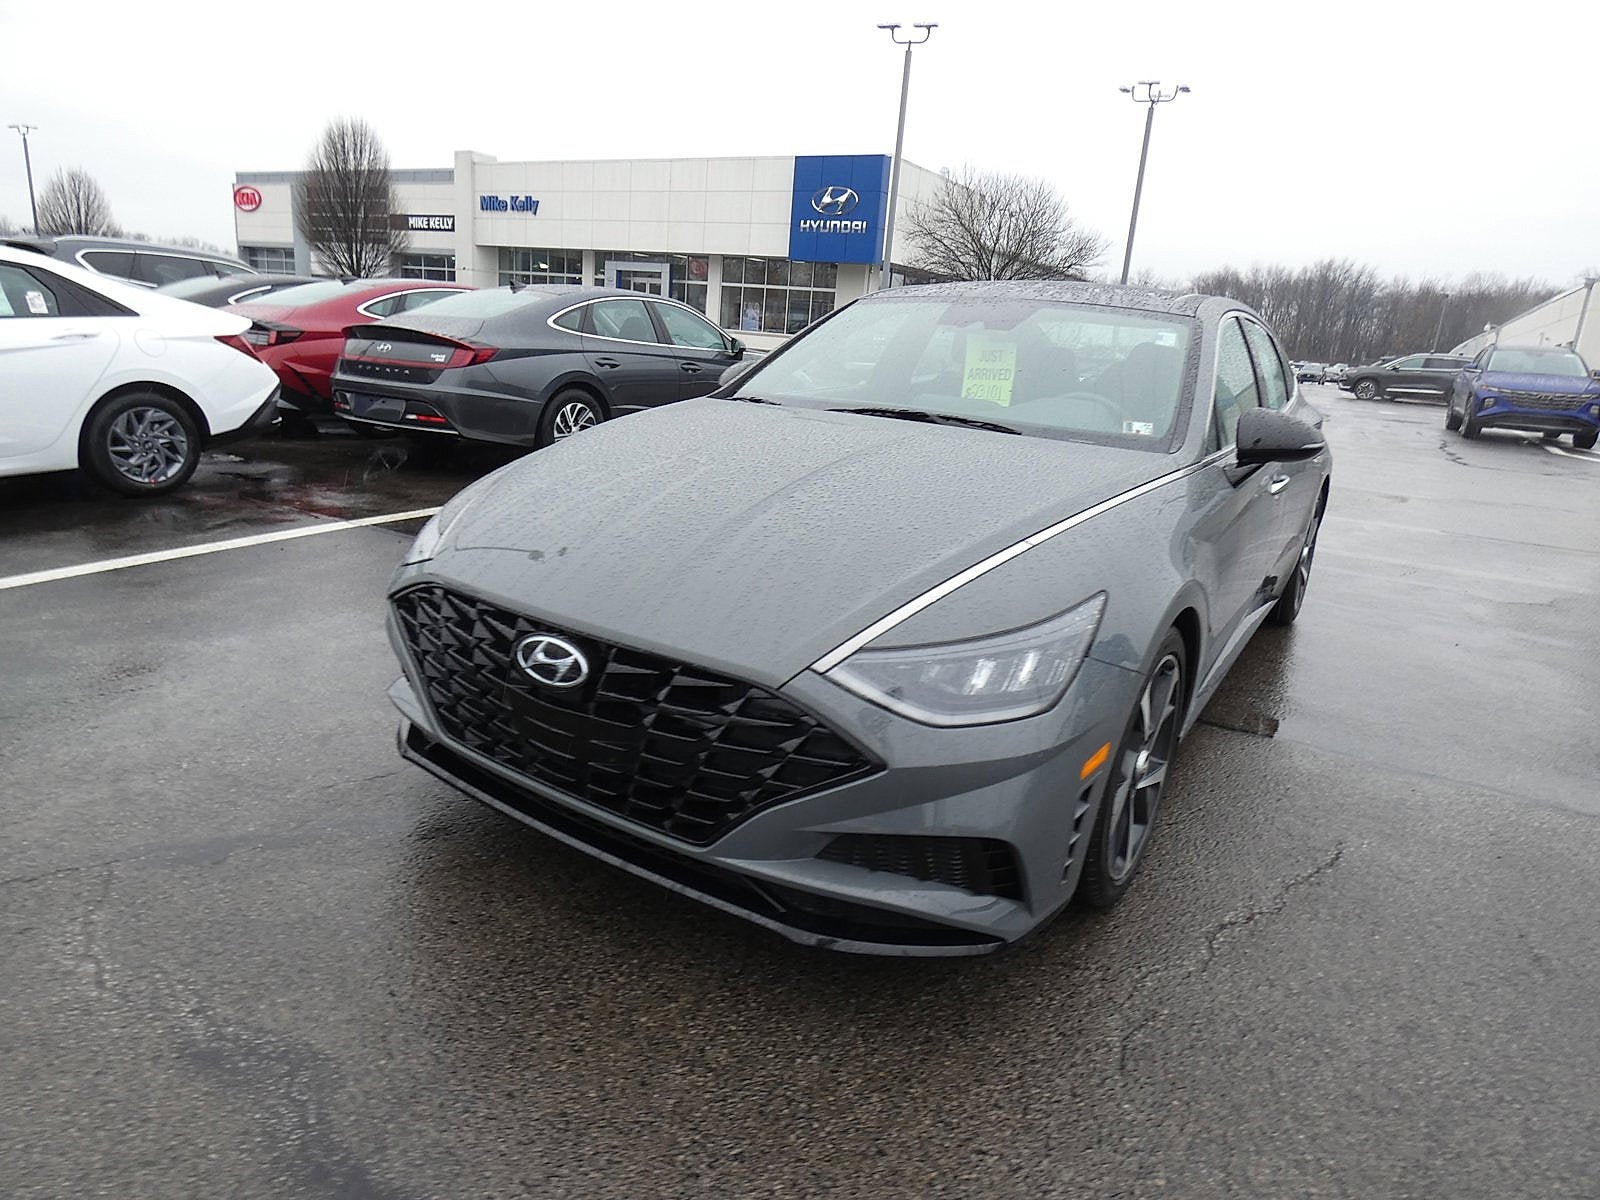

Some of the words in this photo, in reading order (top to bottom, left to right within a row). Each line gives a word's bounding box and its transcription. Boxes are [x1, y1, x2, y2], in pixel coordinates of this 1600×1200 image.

[480, 195, 508, 211] Mike
[510, 195, 540, 216] Kelly
[408, 216, 429, 229] MIKE
[430, 217, 453, 230] KELLY
[800, 219, 867, 234] HYUNDAI
[978, 349, 1004, 362] JUST
[967, 367, 1012, 381] ARRIVED
